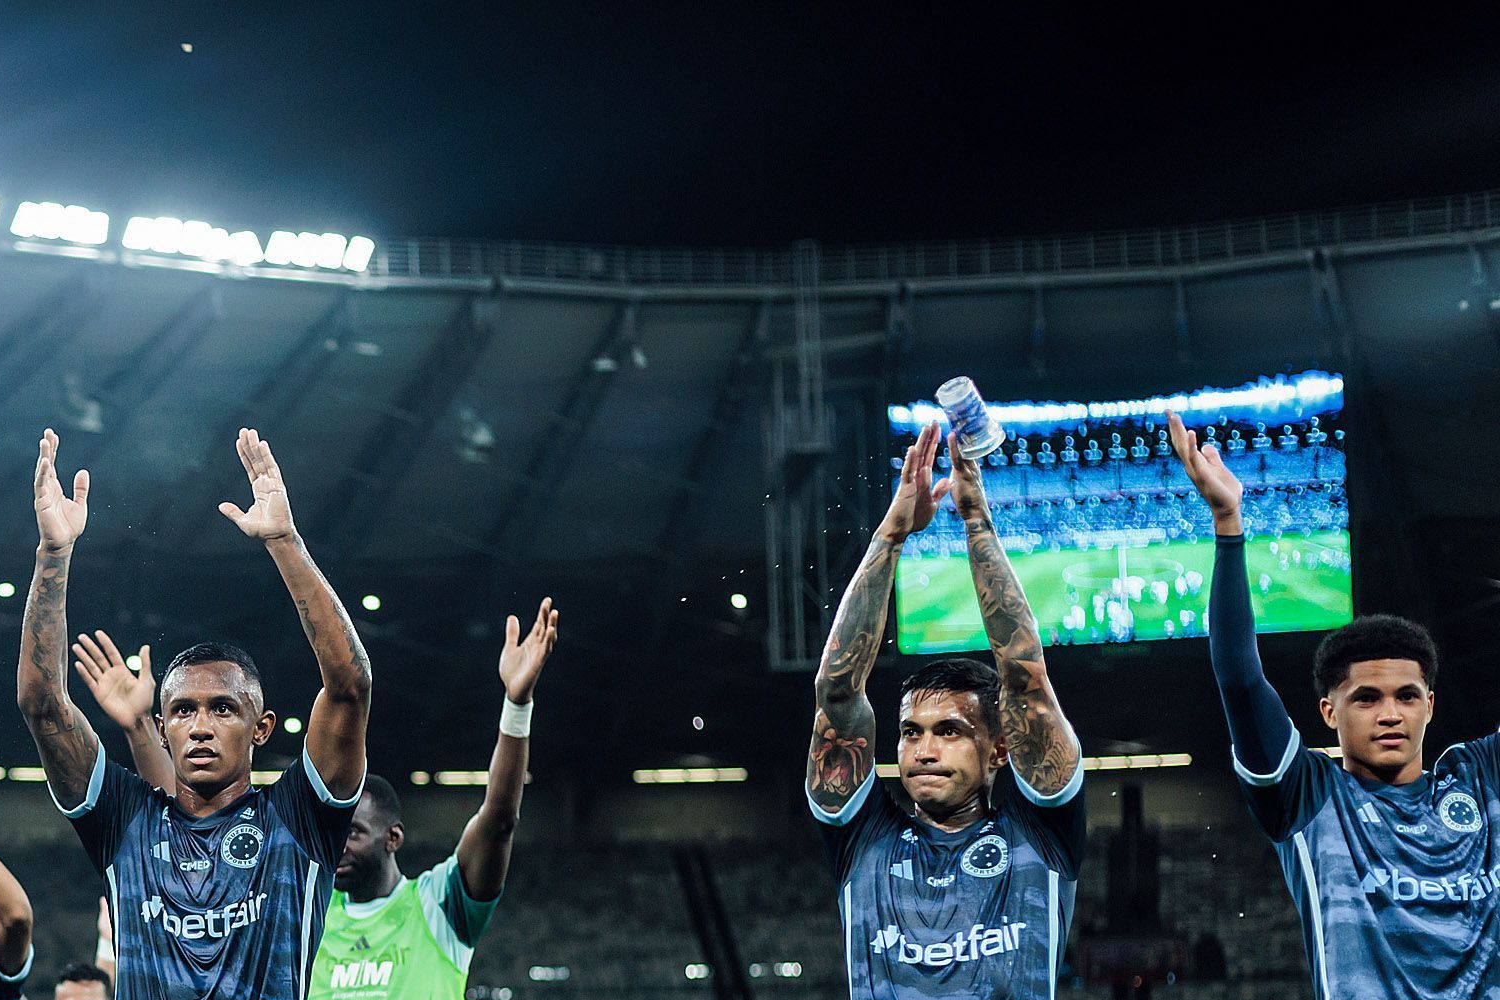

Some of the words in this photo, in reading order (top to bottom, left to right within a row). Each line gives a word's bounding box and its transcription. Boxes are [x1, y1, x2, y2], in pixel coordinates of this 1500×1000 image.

[1396, 824, 1427, 834] CIMED
[180, 860, 211, 872] CIMED
[163, 891, 267, 939] betfair
[898, 916, 1026, 966] betfair
